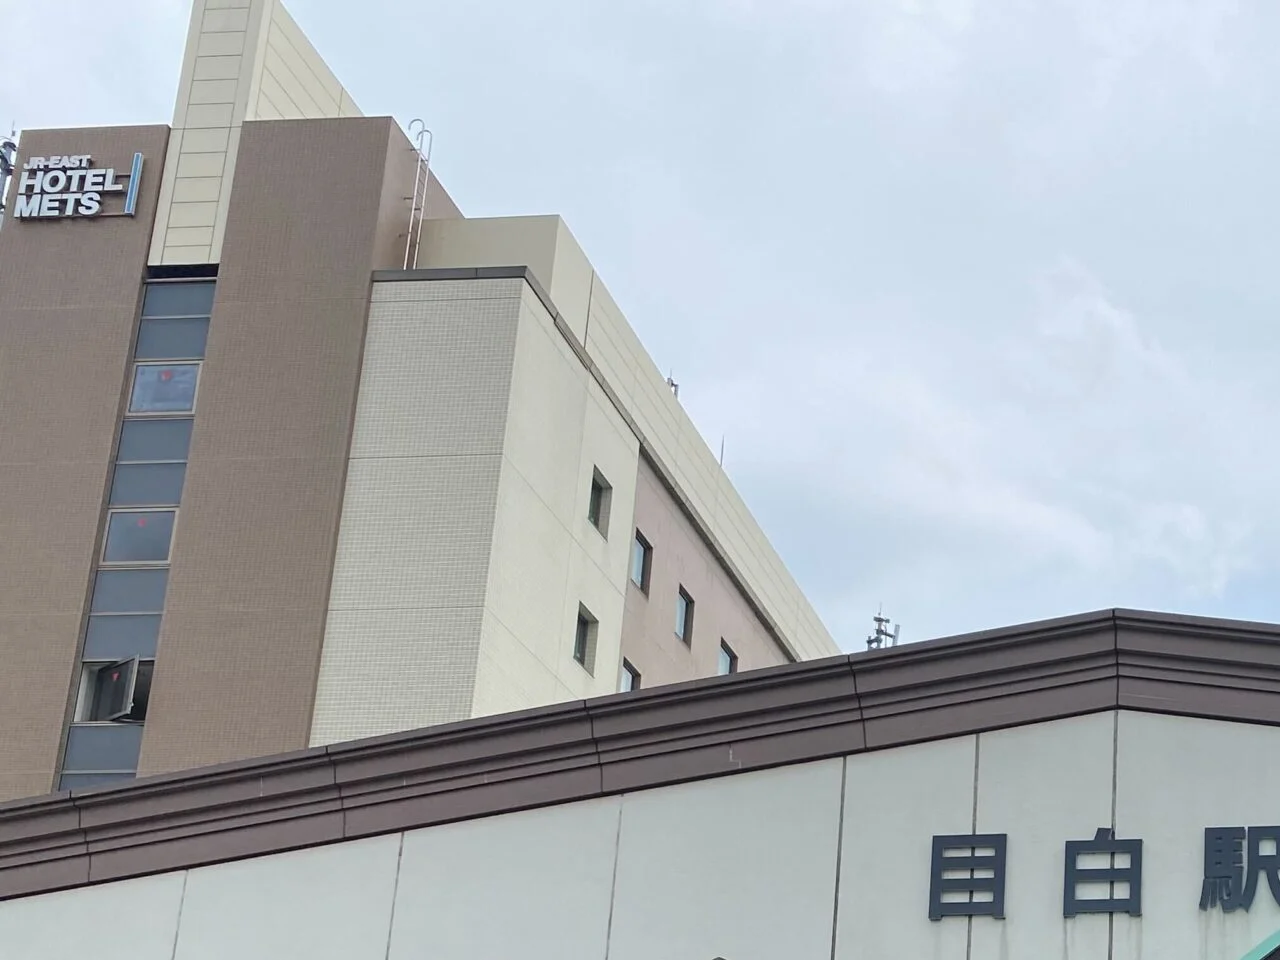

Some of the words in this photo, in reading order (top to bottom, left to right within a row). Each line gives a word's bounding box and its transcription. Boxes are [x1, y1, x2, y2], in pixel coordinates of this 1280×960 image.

[23, 154, 92, 170] JR-EAST
[18, 168, 123, 194] HOTEL
[13, 192, 102, 218] METS
